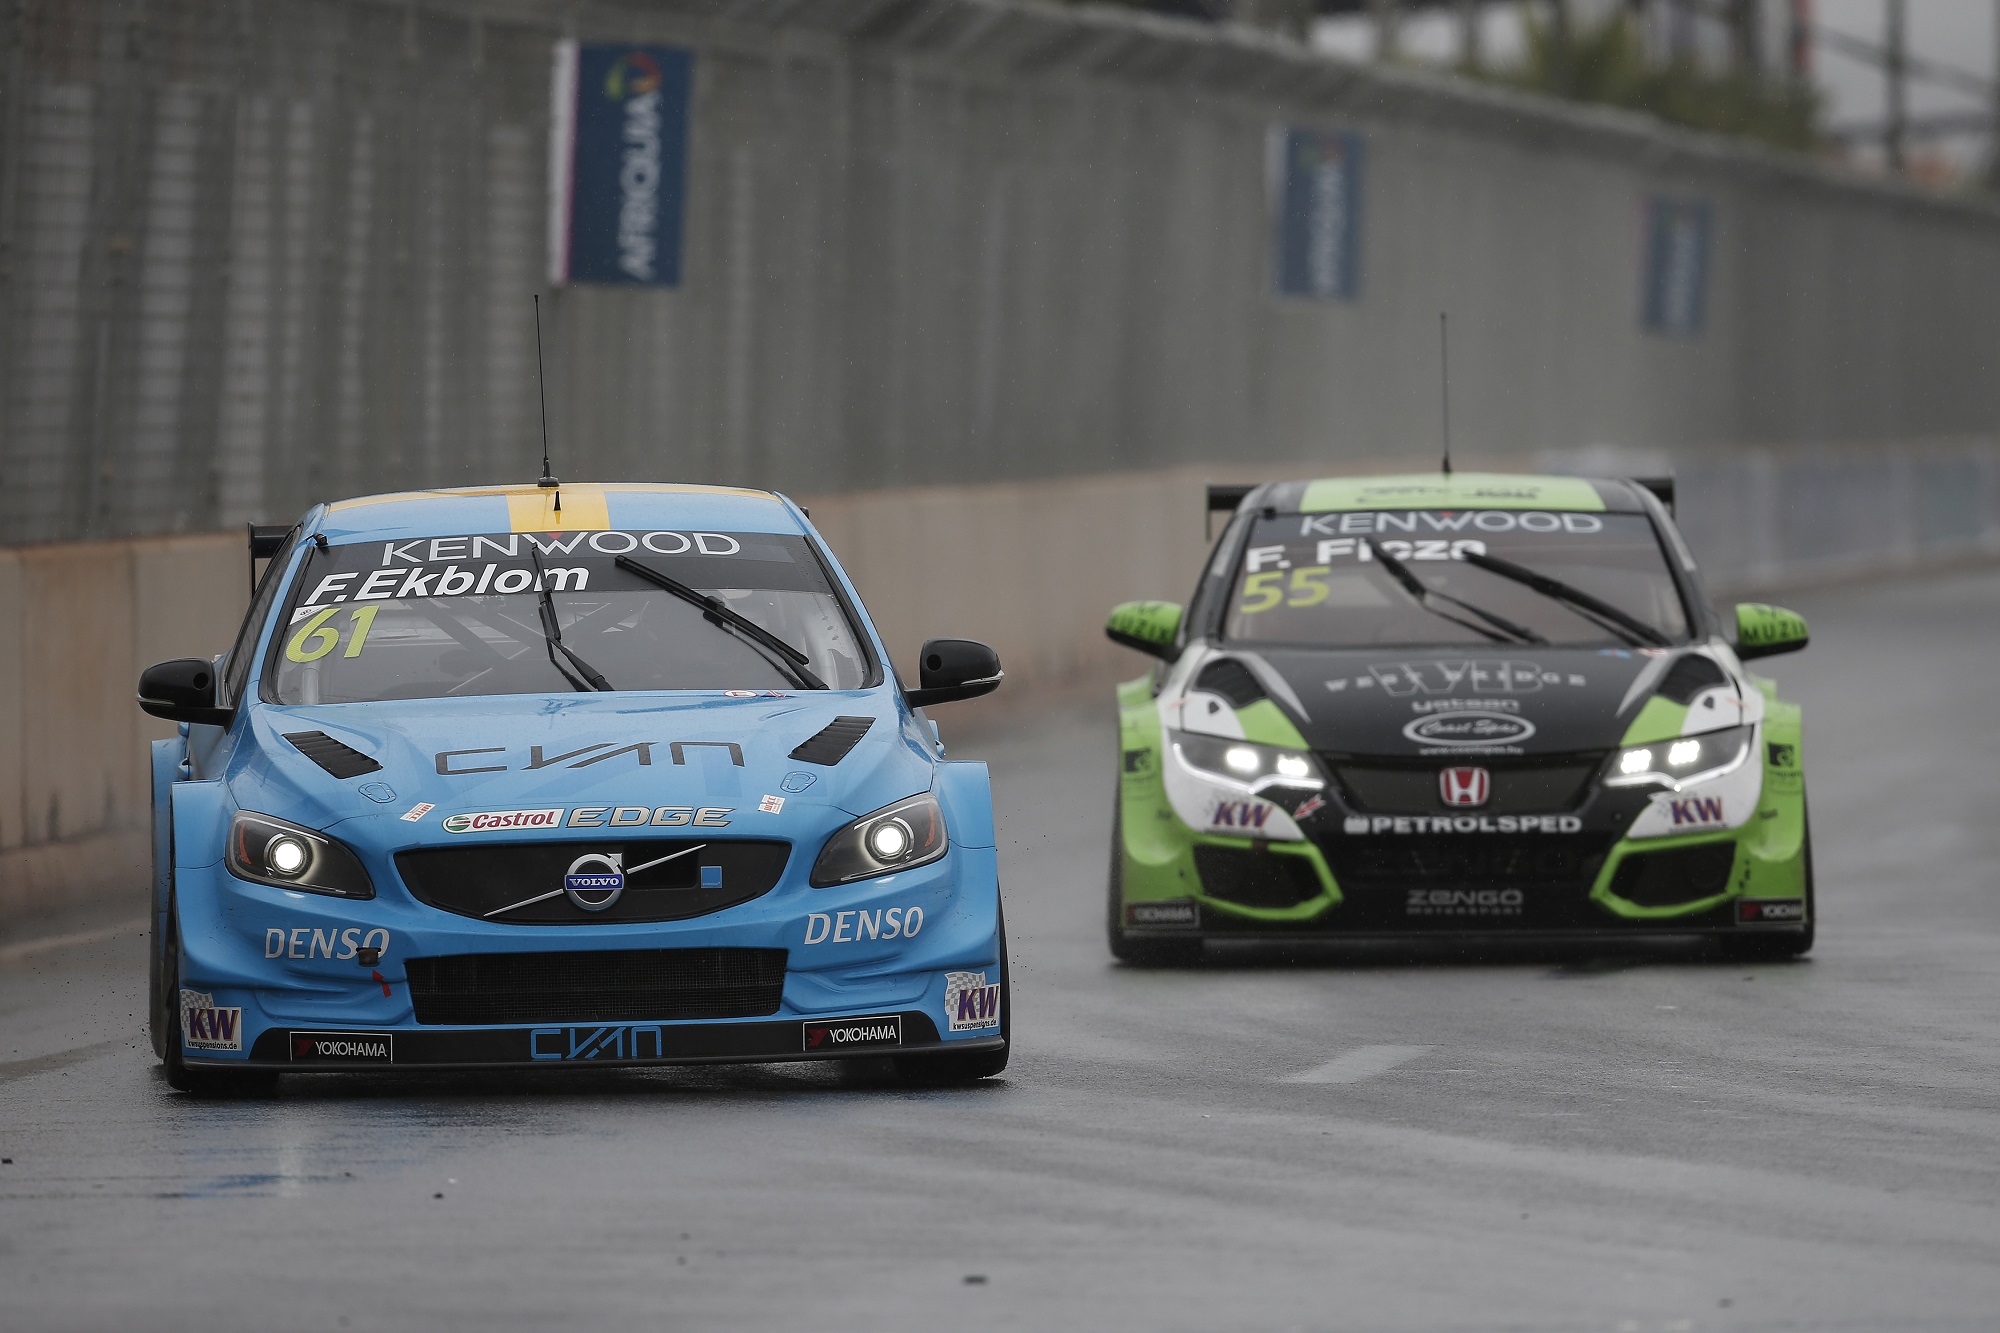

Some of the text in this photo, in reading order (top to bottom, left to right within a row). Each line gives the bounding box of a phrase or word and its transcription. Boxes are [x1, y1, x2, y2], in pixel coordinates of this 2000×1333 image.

[1300, 511, 1604, 537] KENWOOD
[382, 531, 741, 567] KENWOOD
[1245, 545, 1291, 573] F.
[1239, 566, 1333, 614] 55
[285, 605, 381, 663] 61
[472, 806, 737, 830] Castrol EDGE
[1212, 800, 1275, 828] KW
[1371, 814, 1583, 834] PETROLSPED
[1671, 796, 1724, 825] KW
[569, 876, 620, 887] VOLVO
[804, 906, 924, 945] DENSO
[265, 928, 391, 959] DENSO
[957, 986, 1000, 1021] KW
[188, 1007, 240, 1041] KW
[829, 1025, 897, 1044] YOKOHAMA
[315, 1041, 387, 1058] YOKOHAMA
